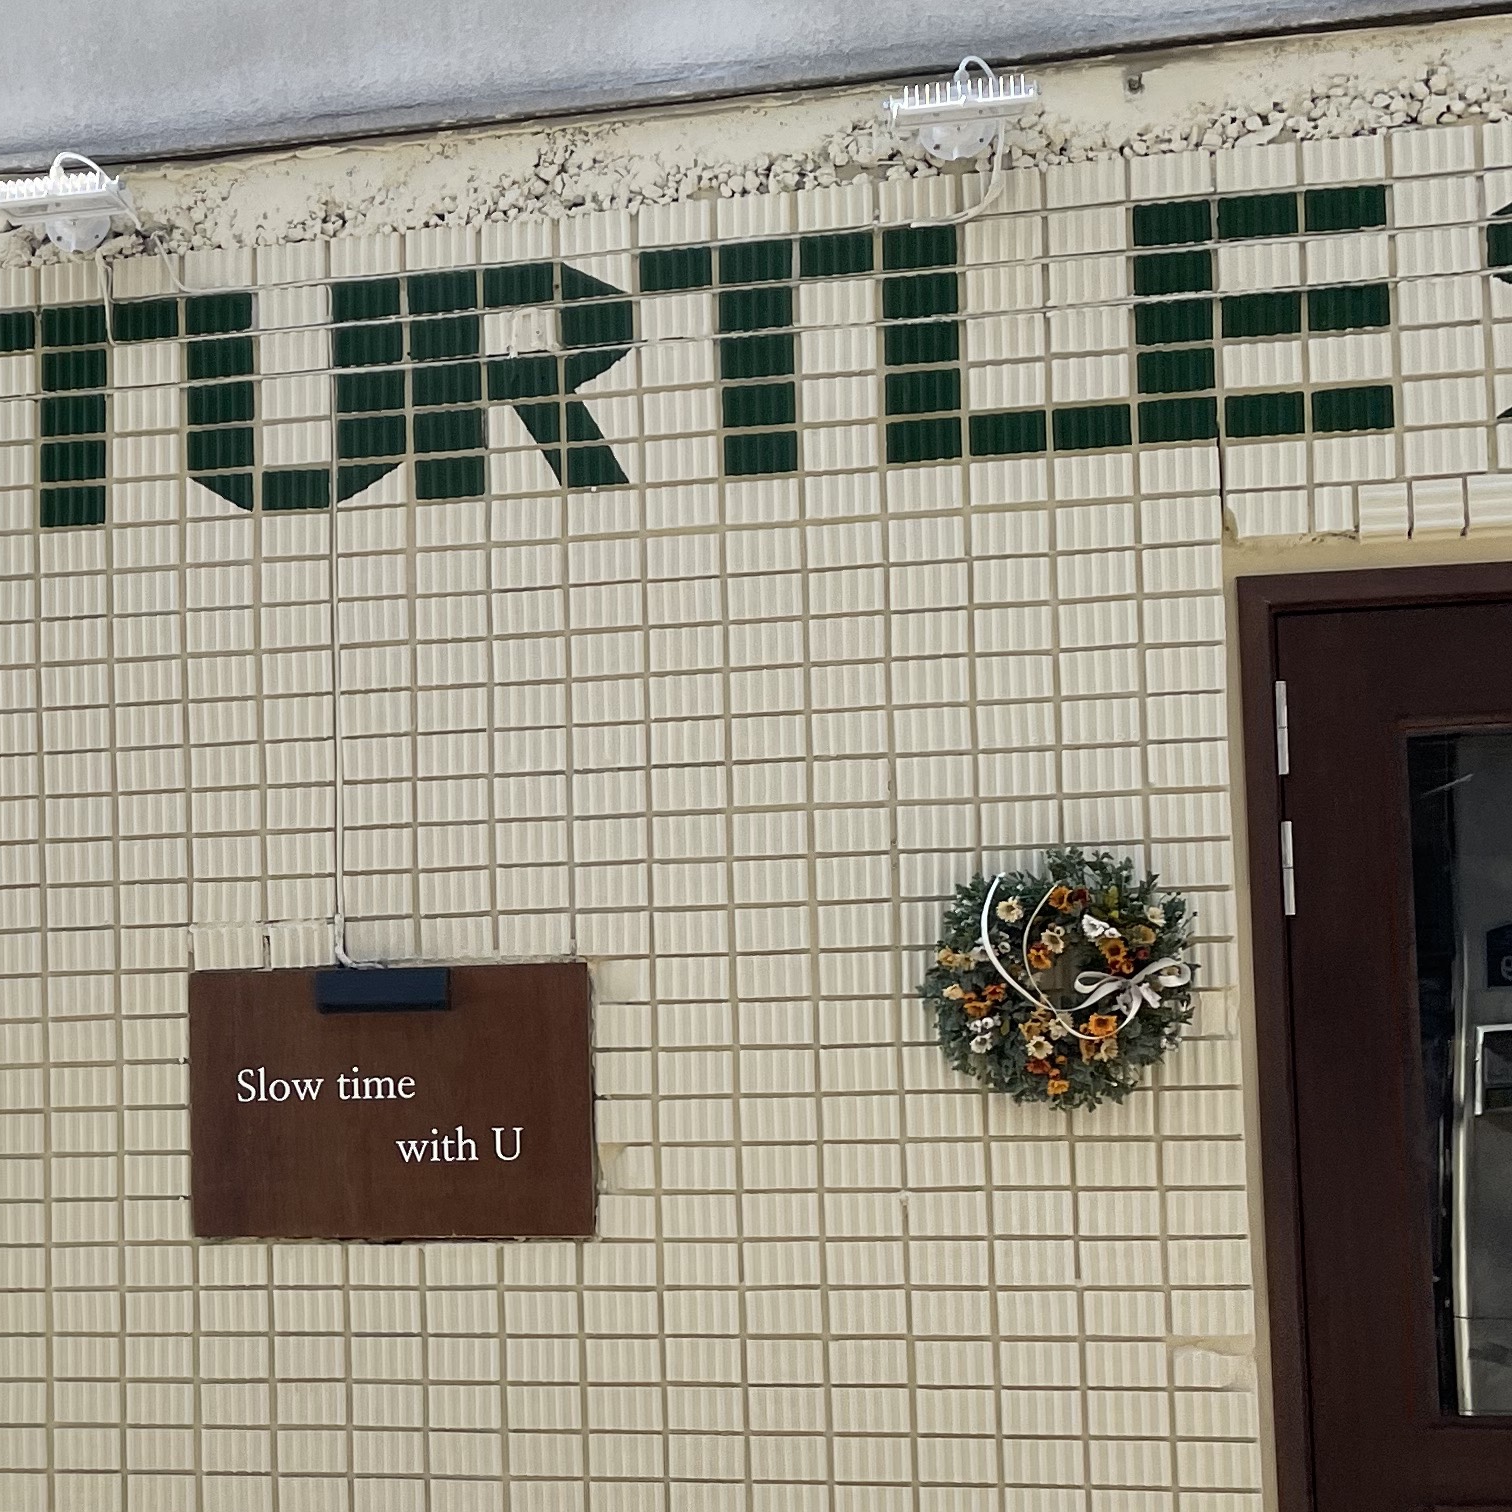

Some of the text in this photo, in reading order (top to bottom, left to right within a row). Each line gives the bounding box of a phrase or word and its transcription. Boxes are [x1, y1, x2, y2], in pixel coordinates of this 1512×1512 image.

[236, 1066, 416, 1103] Slow time
[395, 1126, 524, 1163] with U
